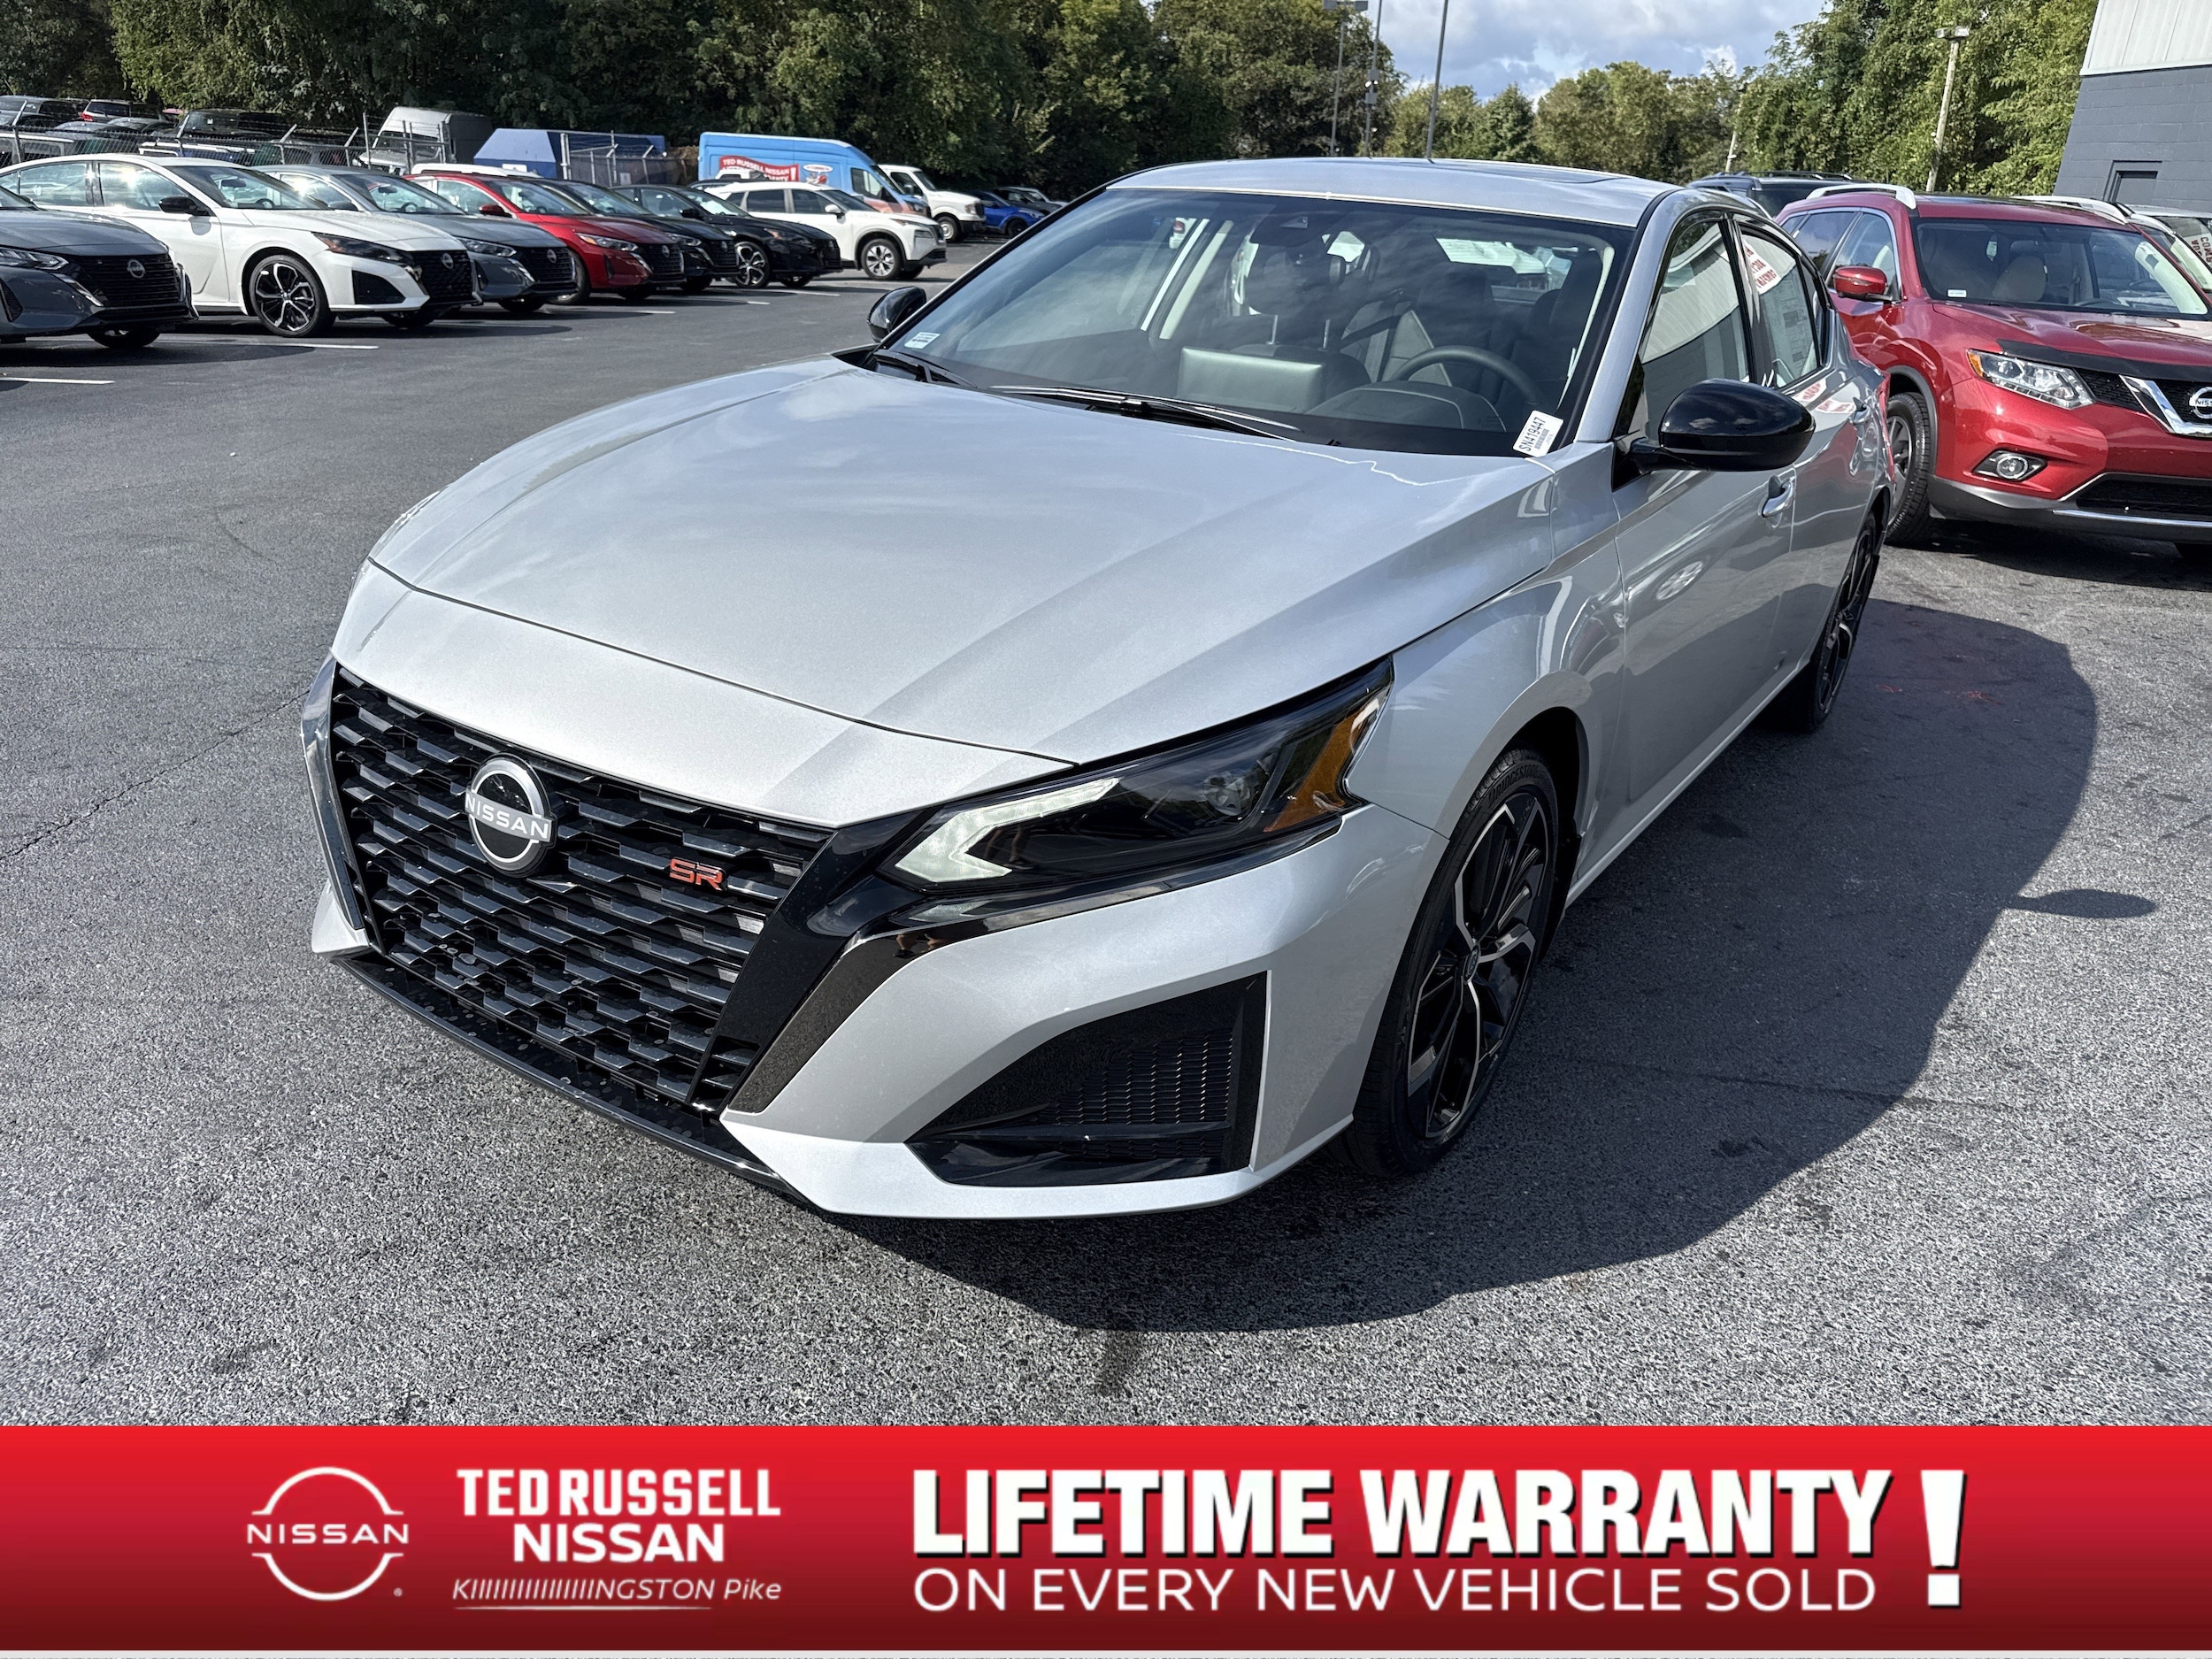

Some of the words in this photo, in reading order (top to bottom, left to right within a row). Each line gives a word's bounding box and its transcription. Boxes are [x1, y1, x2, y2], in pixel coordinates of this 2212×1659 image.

[736, 159, 764, 174] RUSSELL
[764, 167, 789, 176] NISSAN
[1518, 417, 1546, 451] SN419447
[465, 793, 549, 839] NISSAN
[669, 858, 723, 891] SR
